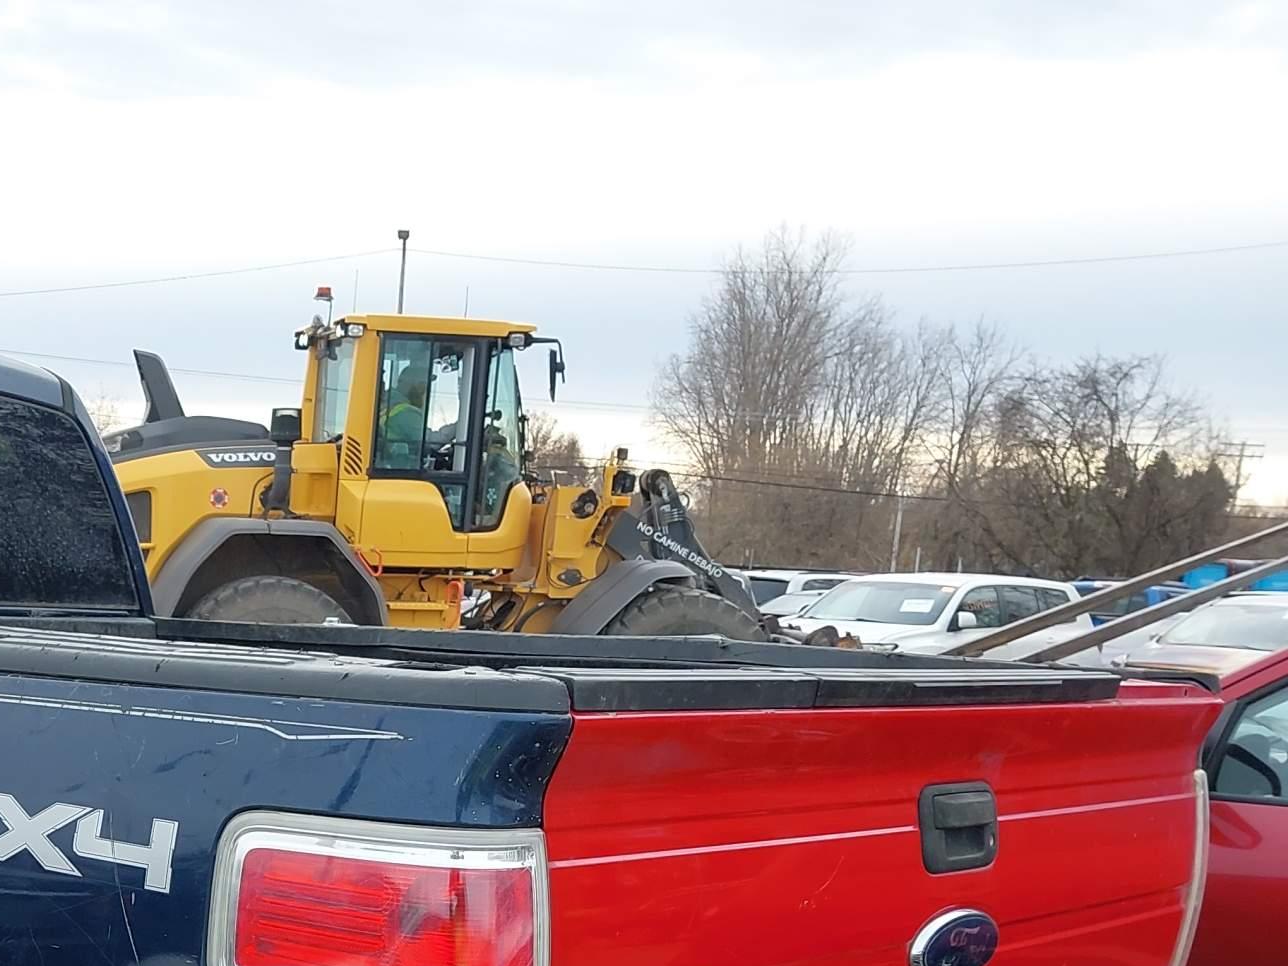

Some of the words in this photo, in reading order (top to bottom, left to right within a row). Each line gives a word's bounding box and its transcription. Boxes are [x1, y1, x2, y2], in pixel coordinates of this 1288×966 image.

[207, 451, 276, 463] VOLVO
[636, 521, 654, 536] NO
[653, 531, 689, 557] CAMINE
[688, 551, 723, 578] DEBAJO
